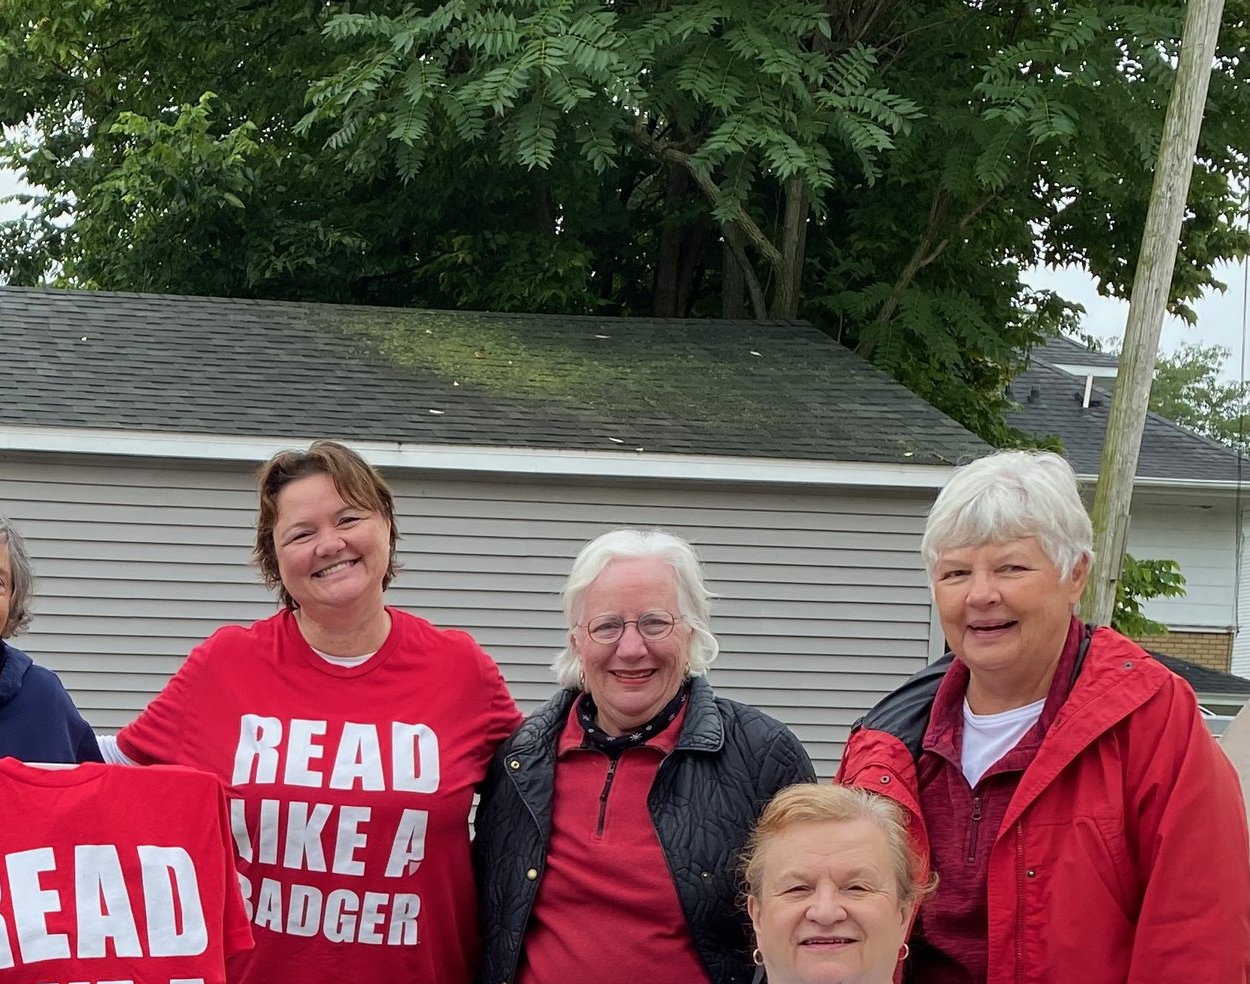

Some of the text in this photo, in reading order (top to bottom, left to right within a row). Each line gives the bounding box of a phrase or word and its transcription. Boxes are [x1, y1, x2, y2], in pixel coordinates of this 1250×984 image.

[232, 713, 441, 794] READ
[230, 798, 429, 878] LIKE A
[237, 871, 421, 946] BADGER
